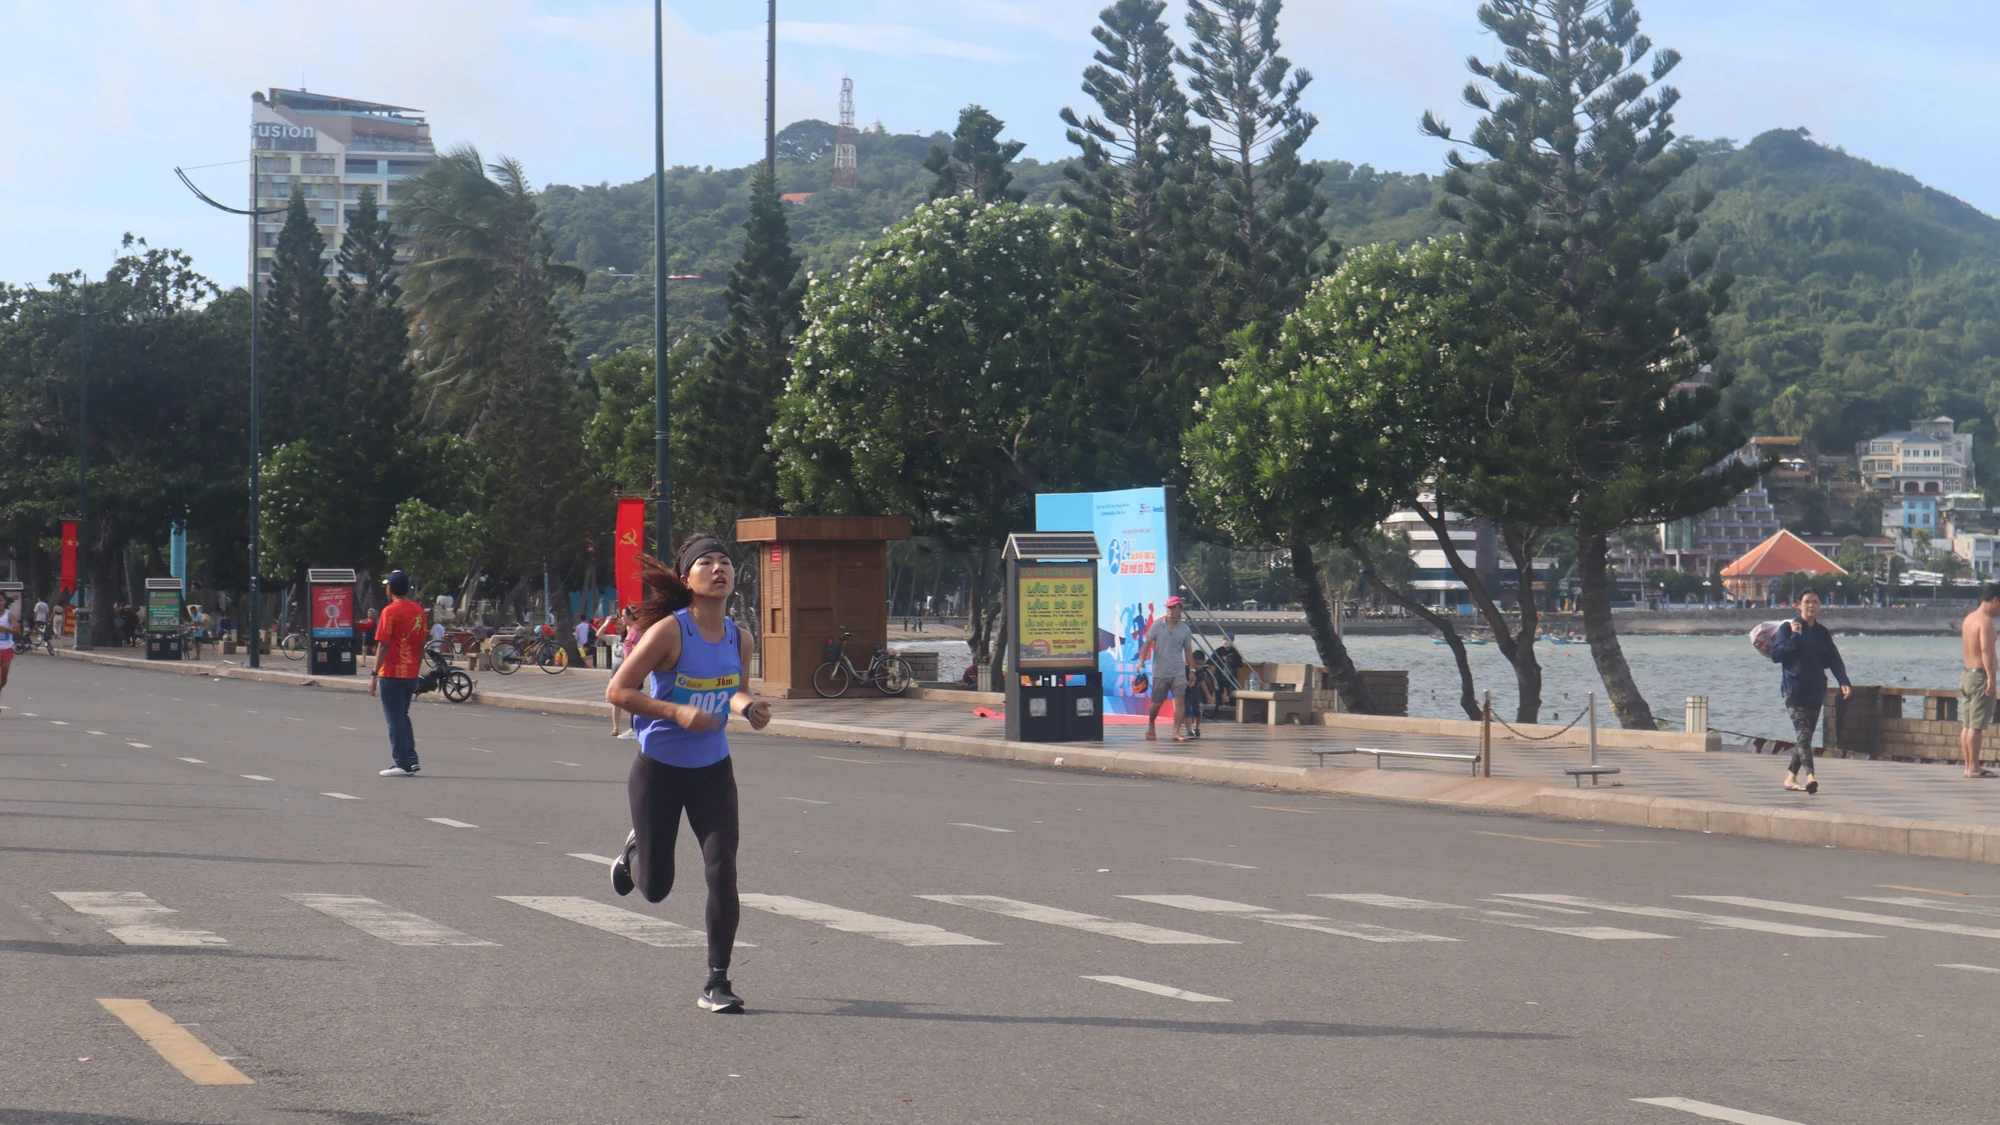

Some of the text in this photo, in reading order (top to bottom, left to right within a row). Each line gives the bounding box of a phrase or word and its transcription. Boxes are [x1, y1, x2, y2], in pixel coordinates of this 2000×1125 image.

[251, 122, 315, 139] fusion
[1071, 584, 1085, 594] 69
[1071, 600, 1085, 610] 69
[688, 691, 728, 714] 002
